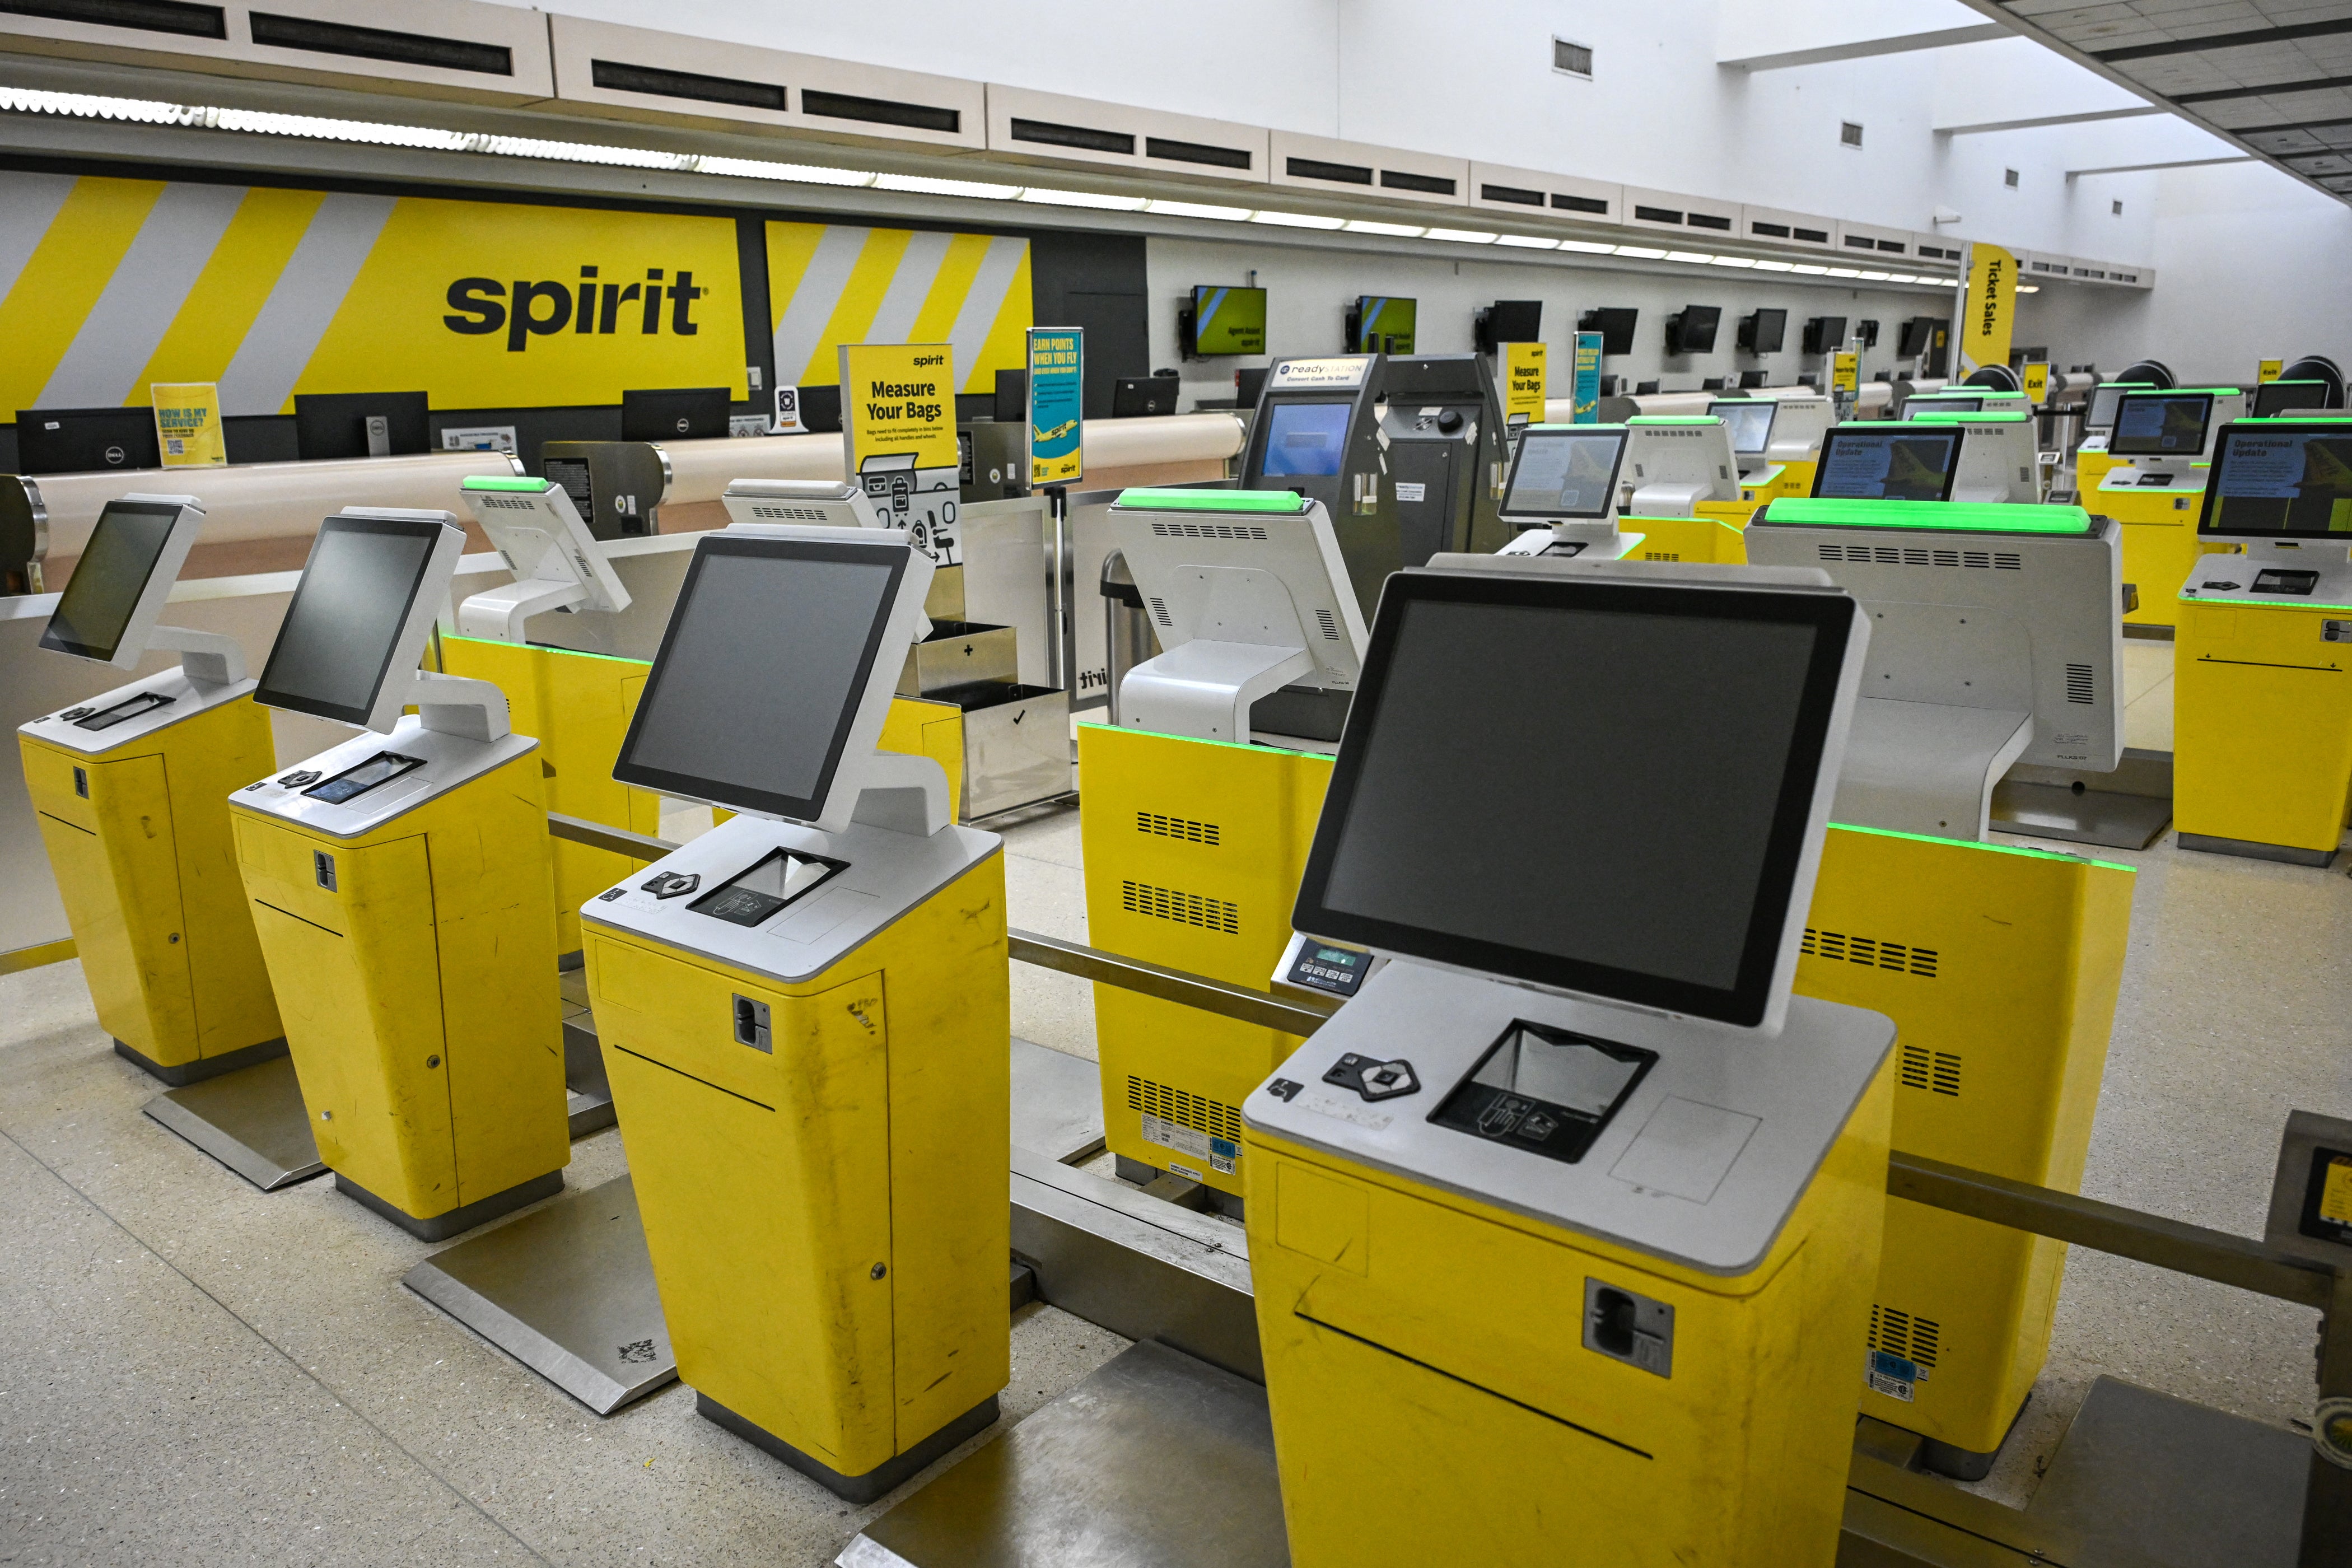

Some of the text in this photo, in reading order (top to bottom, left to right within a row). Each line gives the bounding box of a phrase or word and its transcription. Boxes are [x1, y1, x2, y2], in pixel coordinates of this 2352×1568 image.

[1982, 259, 2001, 336] Ticket Sales
[443, 265, 701, 352] spirit
[1034, 338, 1074, 351] EARN POINTS
[913, 355, 944, 368] spirit
[1034, 352, 1077, 365] WHEN YOU FLY
[1514, 366, 1539, 376] Measure
[871, 381, 935, 398] Measure
[1512, 380, 1541, 393] Your Bags
[2028, 379, 2042, 389] Exit
[158, 408, 207, 418] HOW IS MY
[866, 402, 942, 422] Your Bags
[160, 418, 203, 428] SERVICE?
[2234, 440, 2293, 450] Operational
[2232, 449, 2267, 458] Update
[1061, 465, 1075, 474] spirit
